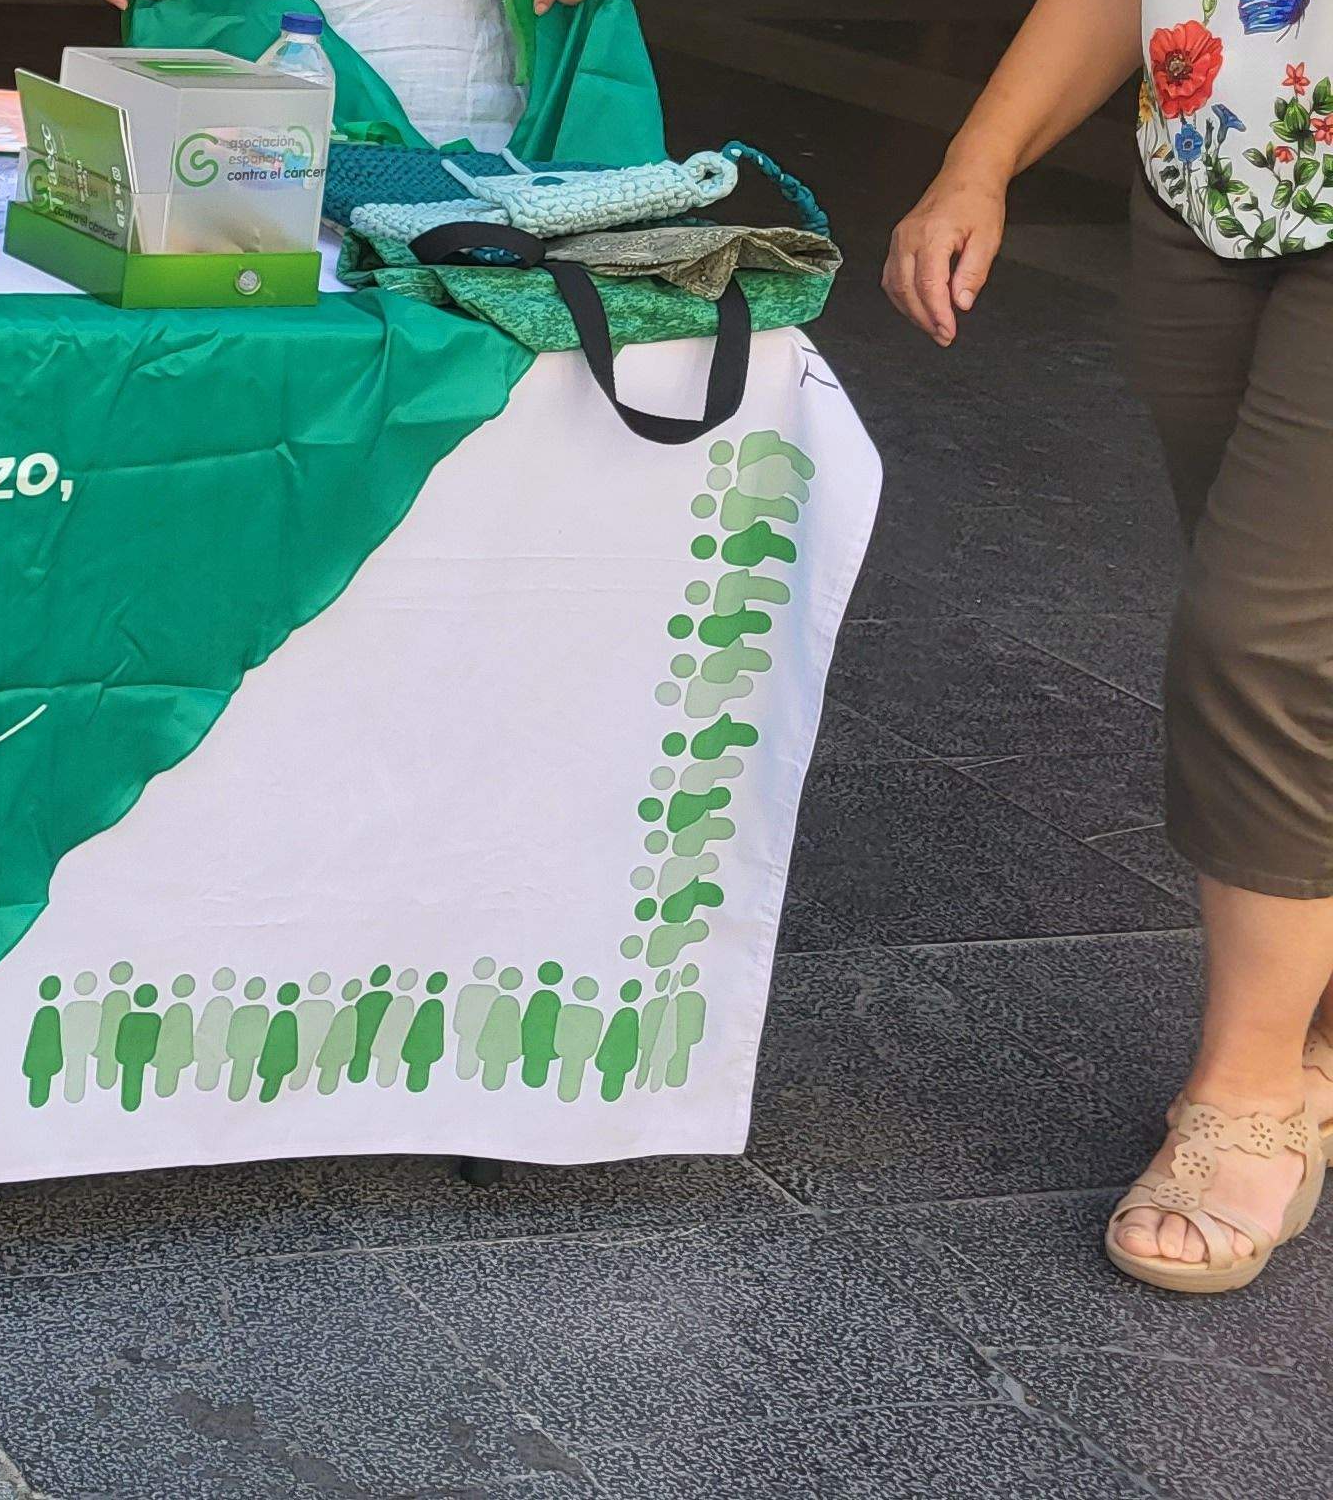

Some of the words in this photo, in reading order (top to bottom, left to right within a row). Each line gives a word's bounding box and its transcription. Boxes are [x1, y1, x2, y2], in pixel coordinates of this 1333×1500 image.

[229, 135, 295, 149] asociación
[227, 168, 267, 181] contra
[270, 167, 281, 179] el
[284, 167, 326, 179] cáncer
